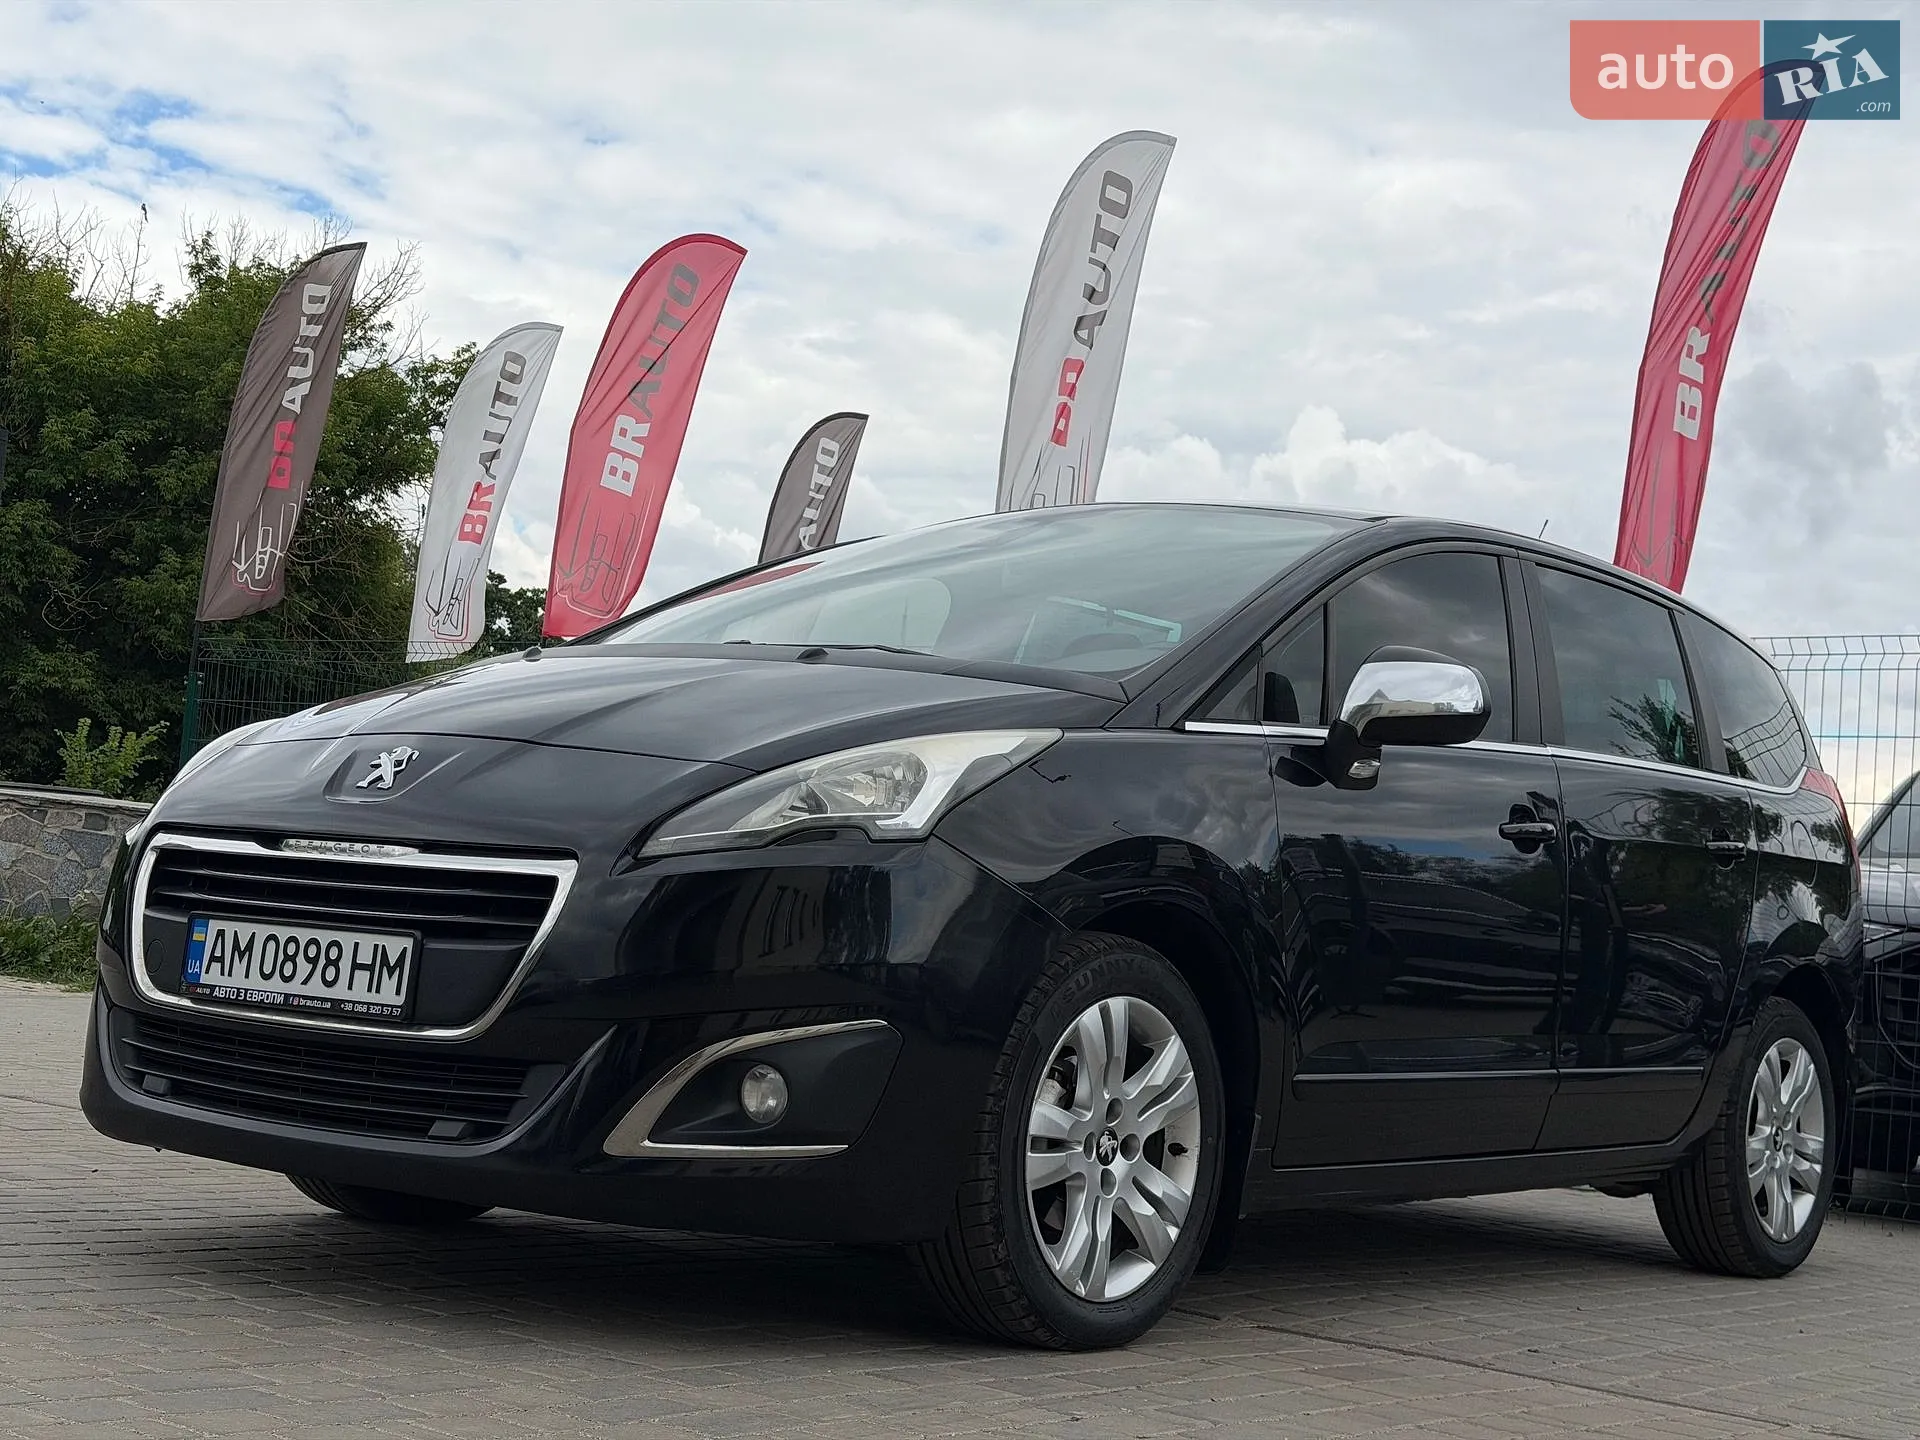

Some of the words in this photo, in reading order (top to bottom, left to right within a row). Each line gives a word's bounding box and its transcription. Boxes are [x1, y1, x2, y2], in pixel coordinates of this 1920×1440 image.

[599, 262, 701, 497] BRAUTO
[457, 350, 528, 546] BRAUTO
[293, 840, 385, 855] PEUGEOT
[187, 959, 200, 974] UA
[212, 986, 237, 999] АВТО
[299, 997, 331, 1009] brauto.ua
[340, 1002, 353, 1011] +38
[353, 1003, 367, 1013] 068
[368, 1005, 381, 1014] 320
[382, 1006, 391, 1015] 57
[391, 1007, 402, 1016] 57
